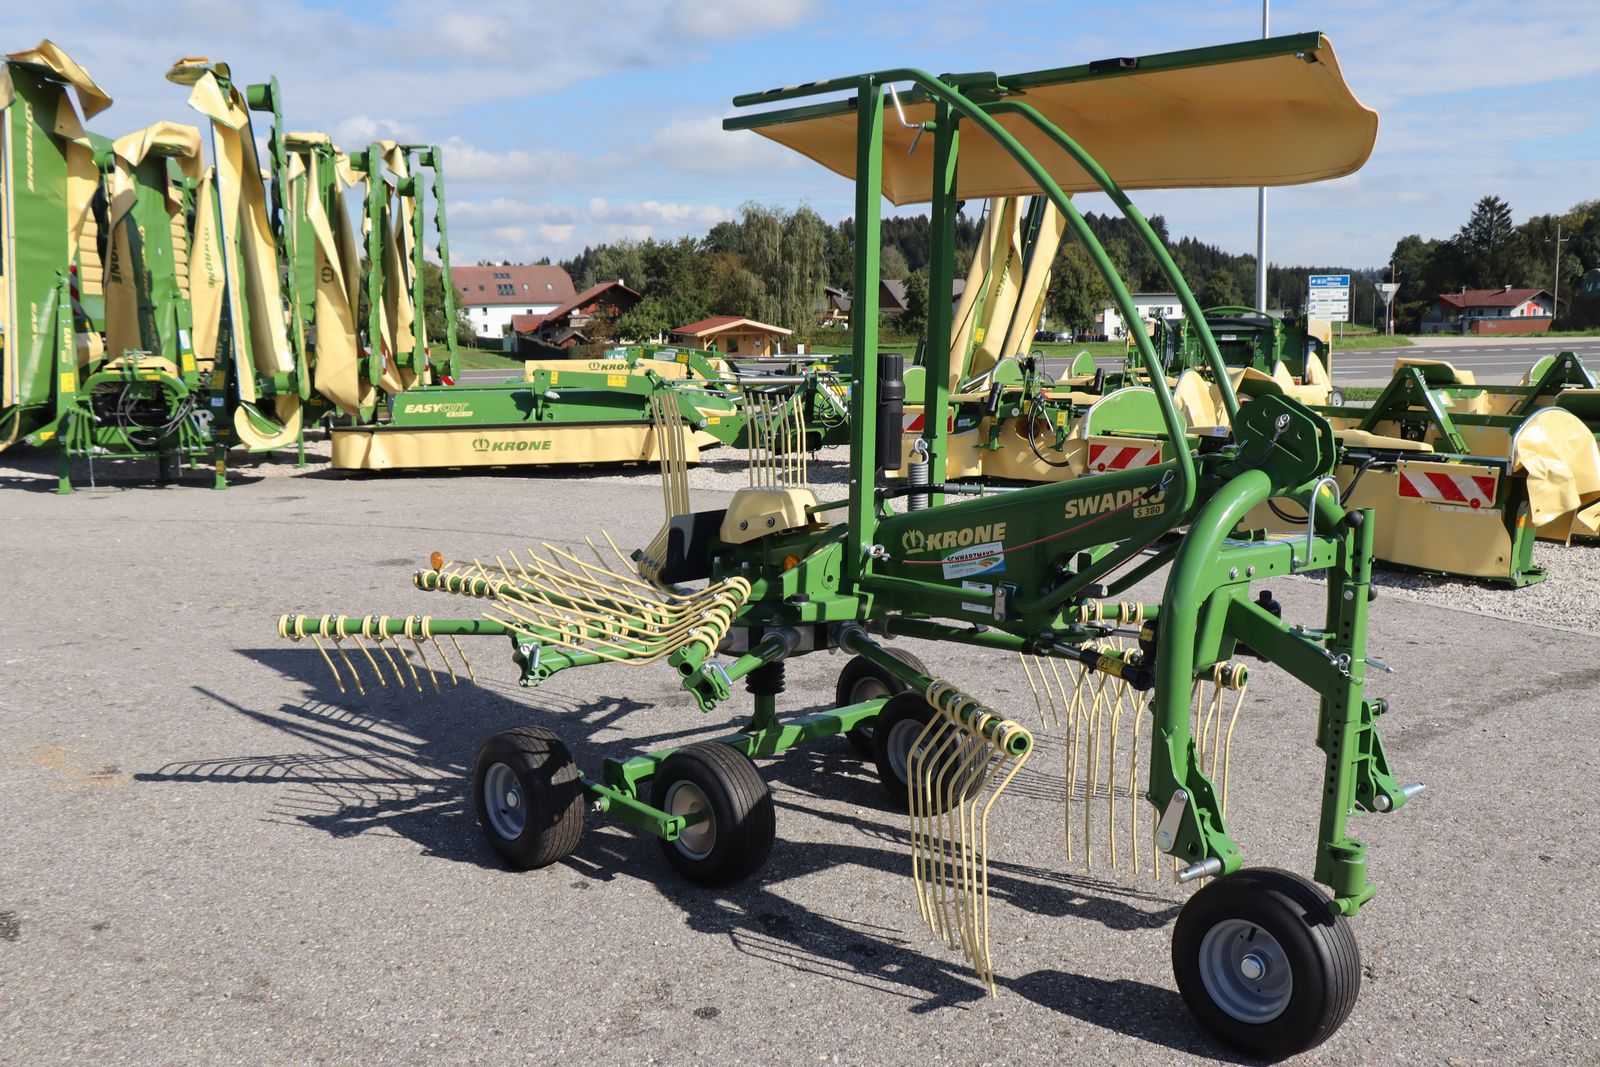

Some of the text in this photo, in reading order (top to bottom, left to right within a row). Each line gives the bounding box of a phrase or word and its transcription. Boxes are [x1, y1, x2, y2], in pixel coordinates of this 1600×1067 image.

[601, 363, 637, 371] KRON
[404, 402, 469, 414] EASYCUT
[492, 440, 552, 452] KRONE
[1064, 484, 1166, 519] SWADRO
[1137, 503, 1161, 516] S 380
[927, 522, 1006, 551] KRONE
